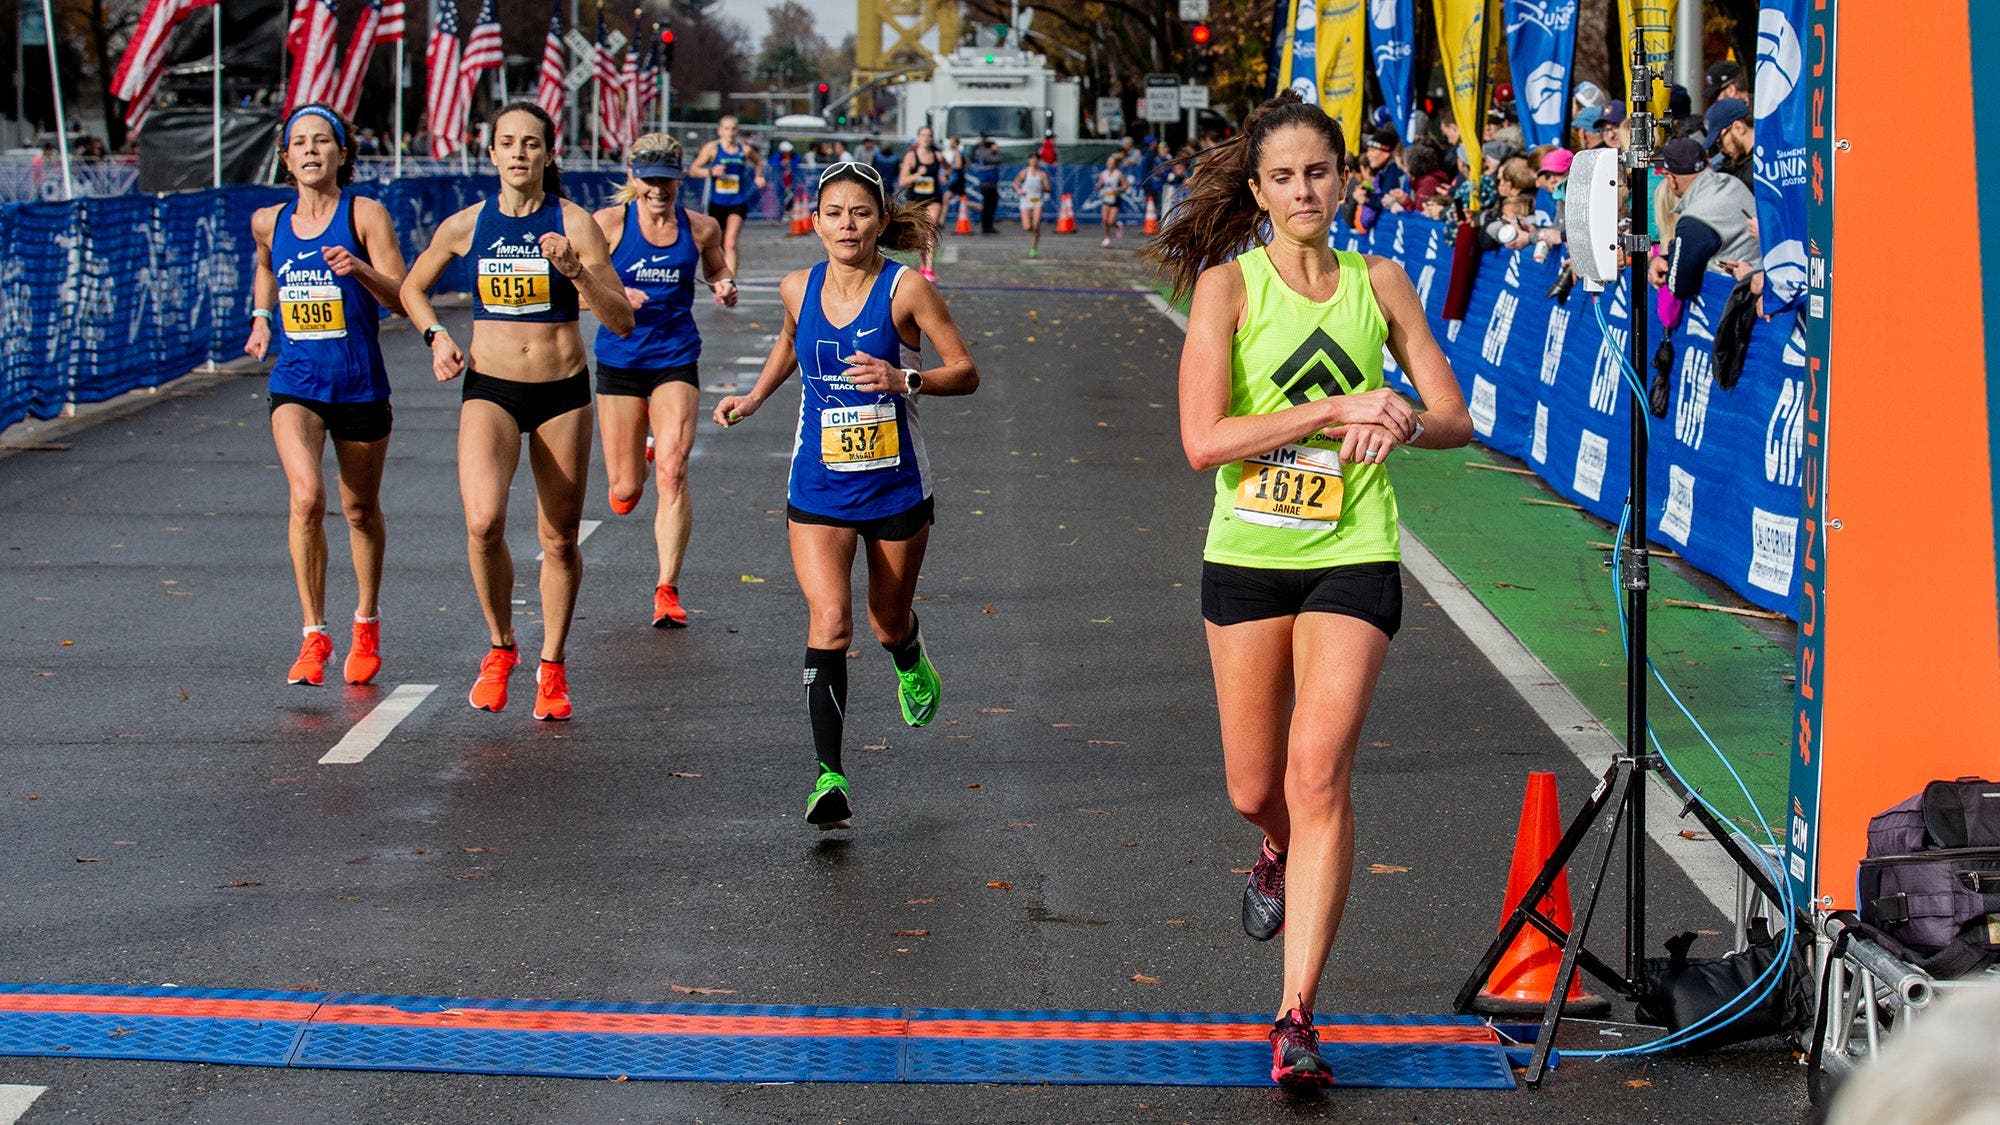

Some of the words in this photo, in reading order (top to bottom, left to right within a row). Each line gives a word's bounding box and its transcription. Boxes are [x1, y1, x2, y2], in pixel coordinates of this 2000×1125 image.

[496, 245, 540, 255] IMPALA
[286, 269, 333, 282] IMPALA
[488, 262, 513, 273] CIM
[635, 268, 680, 279] IMPALA
[1810, 255, 1825, 290] CIM
[288, 290, 311, 300] CIM
[490, 277, 537, 299] 6151
[291, 302, 333, 324] 4396
[1481, 288, 1520, 368] CIM
[829, 383, 855, 391] TRACK
[1675, 346, 1714, 451] CIM
[831, 410, 859, 424] CIM
[840, 425, 879, 453] 537
[1255, 466, 1326, 509] 1612
[1272, 503, 1301, 516] JANAE
[1798, 356, 1821, 768] #RUNCIM
[1792, 814, 1809, 854] CIM
